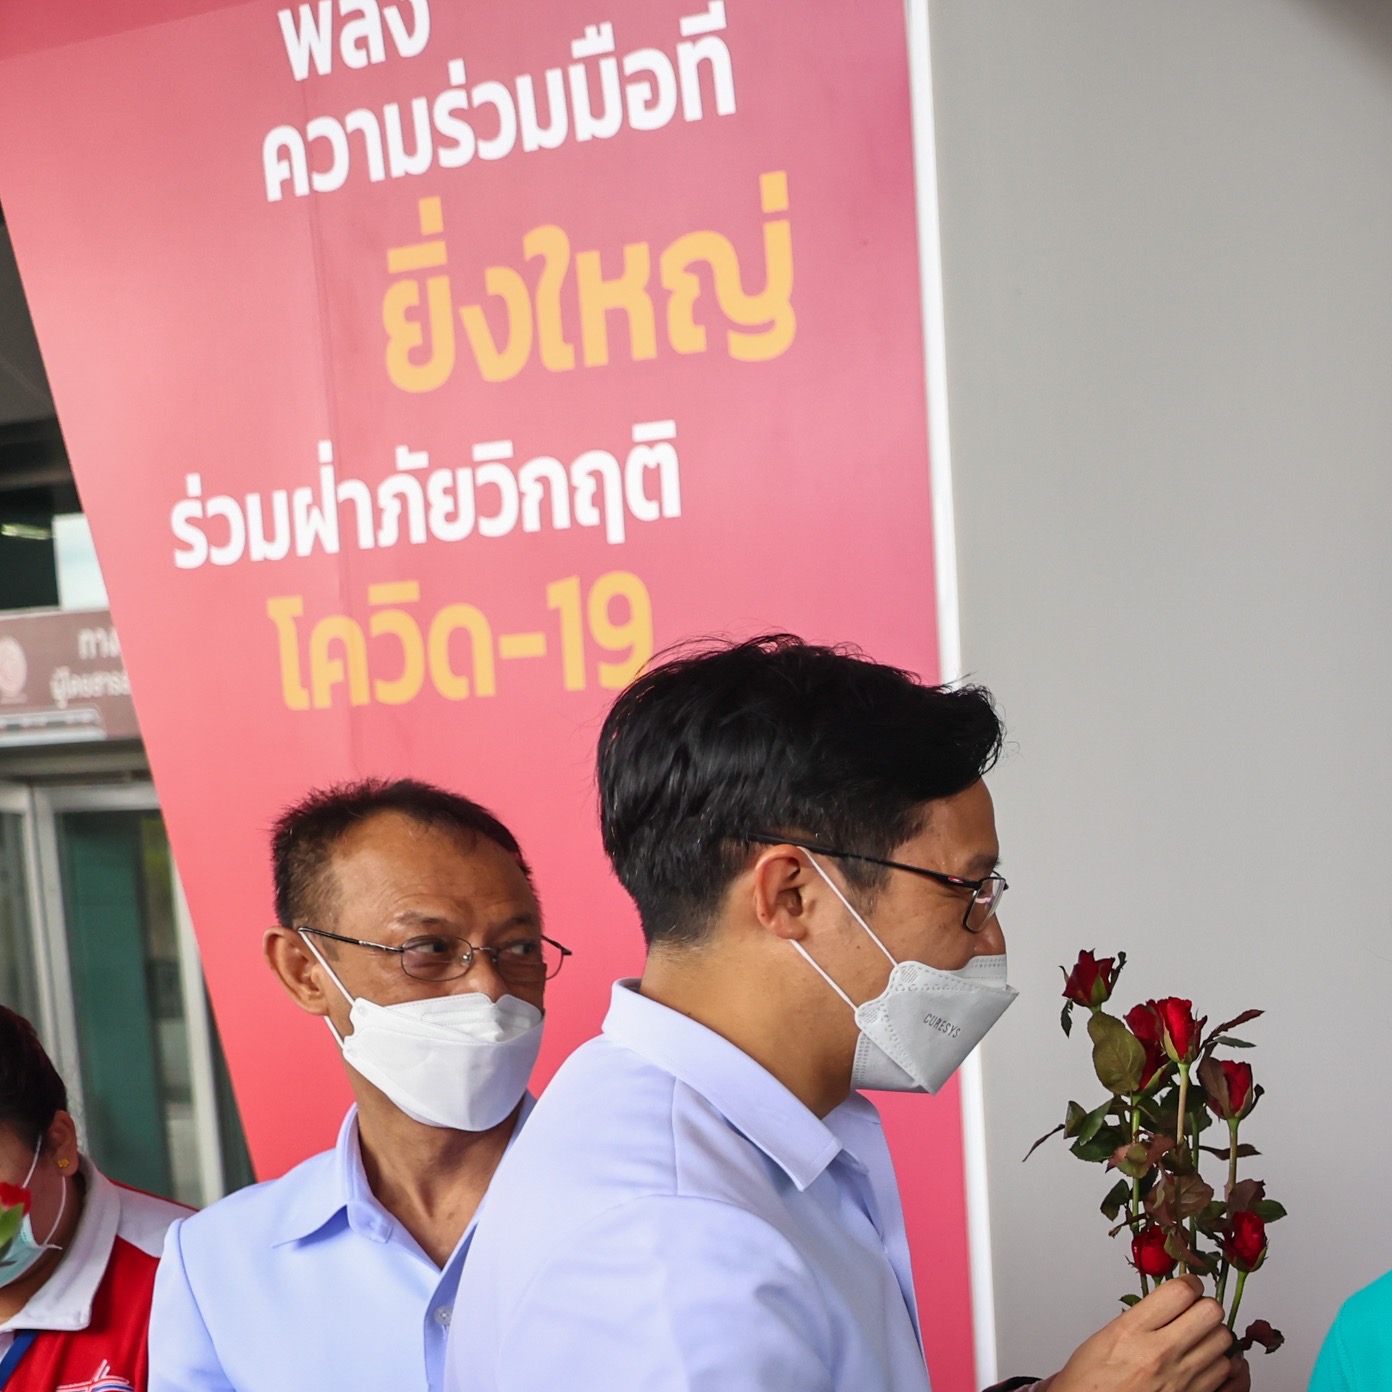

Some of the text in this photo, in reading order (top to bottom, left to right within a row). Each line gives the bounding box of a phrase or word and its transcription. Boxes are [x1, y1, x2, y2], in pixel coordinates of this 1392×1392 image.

[263, 0, 737, 202] ความร่วมมือที
[383, 170, 797, 393] ยิ่งใหญ่
[170, 420, 681, 569] ร่วมฝ่าภัยวิกฤติ
[266, 570, 654, 711] โควิด-19
[922, 1012, 961, 1039] CURESYS
